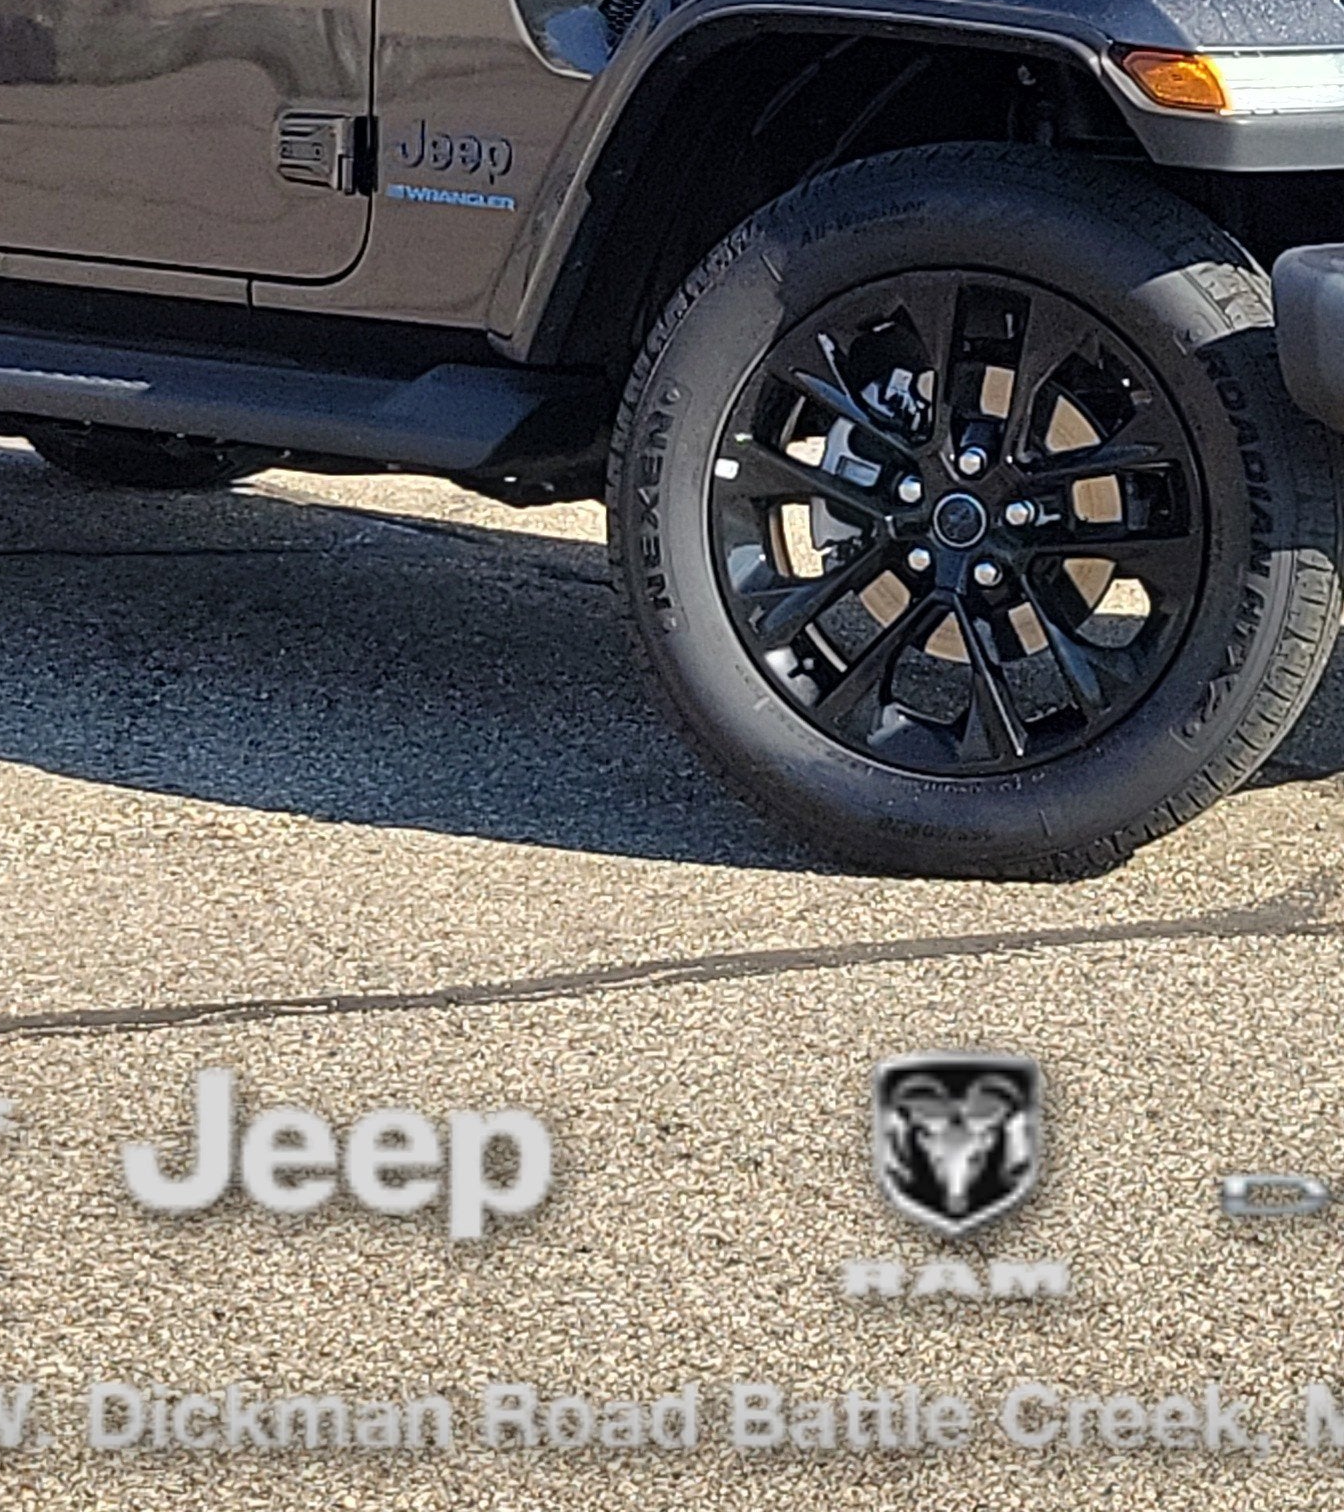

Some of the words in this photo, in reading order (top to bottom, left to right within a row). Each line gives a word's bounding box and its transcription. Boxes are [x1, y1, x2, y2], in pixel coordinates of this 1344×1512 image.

[397, 119, 514, 186] Jeep
[406, 184, 516, 212] WRANGLER
[634, 410, 675, 610] NEXEN
[1197, 347, 1275, 579] ROADIAN
